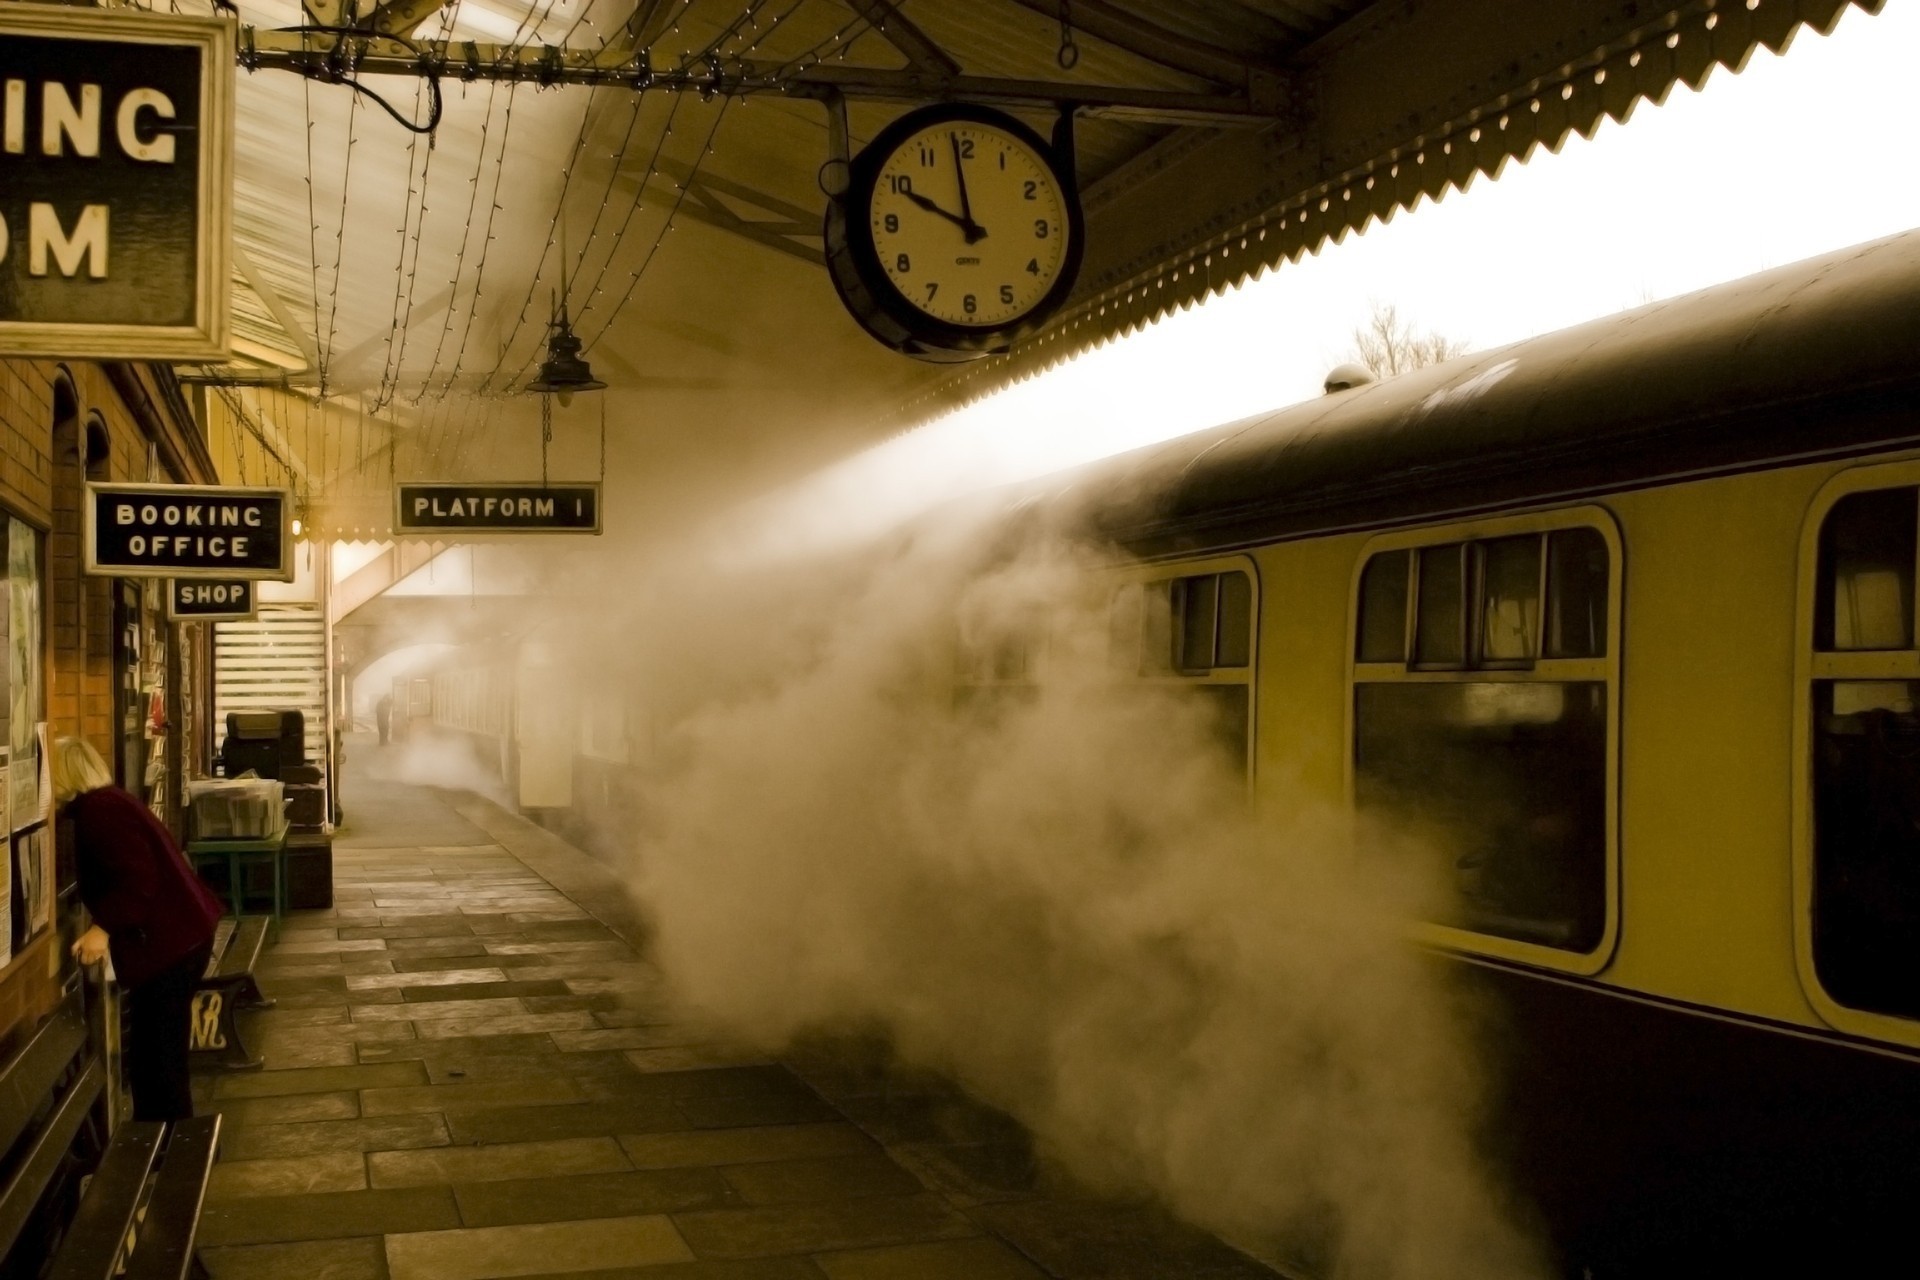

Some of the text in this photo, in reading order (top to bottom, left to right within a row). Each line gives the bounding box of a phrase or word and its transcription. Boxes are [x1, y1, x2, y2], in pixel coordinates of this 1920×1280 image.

[921, 148, 935, 168] 11
[999, 150, 1006, 171] 1
[891, 174, 912, 195] 10
[1023, 180, 1037, 200] 2
[884, 213, 899, 234] 9
[1034, 219, 1049, 239] 3
[0, 201, 109, 278] M
[896, 253, 911, 273] 8
[1025, 257, 1040, 277] 4
[925, 283, 939, 302] 7
[999, 284, 1014, 305] 5
[963, 294, 977, 314] 6
[116, 504, 262, 527] BOOKING
[414, 497, 554, 517] PLATFORM
[128, 535, 249, 558] OFFICE
[180, 584, 244, 604] SHOP
